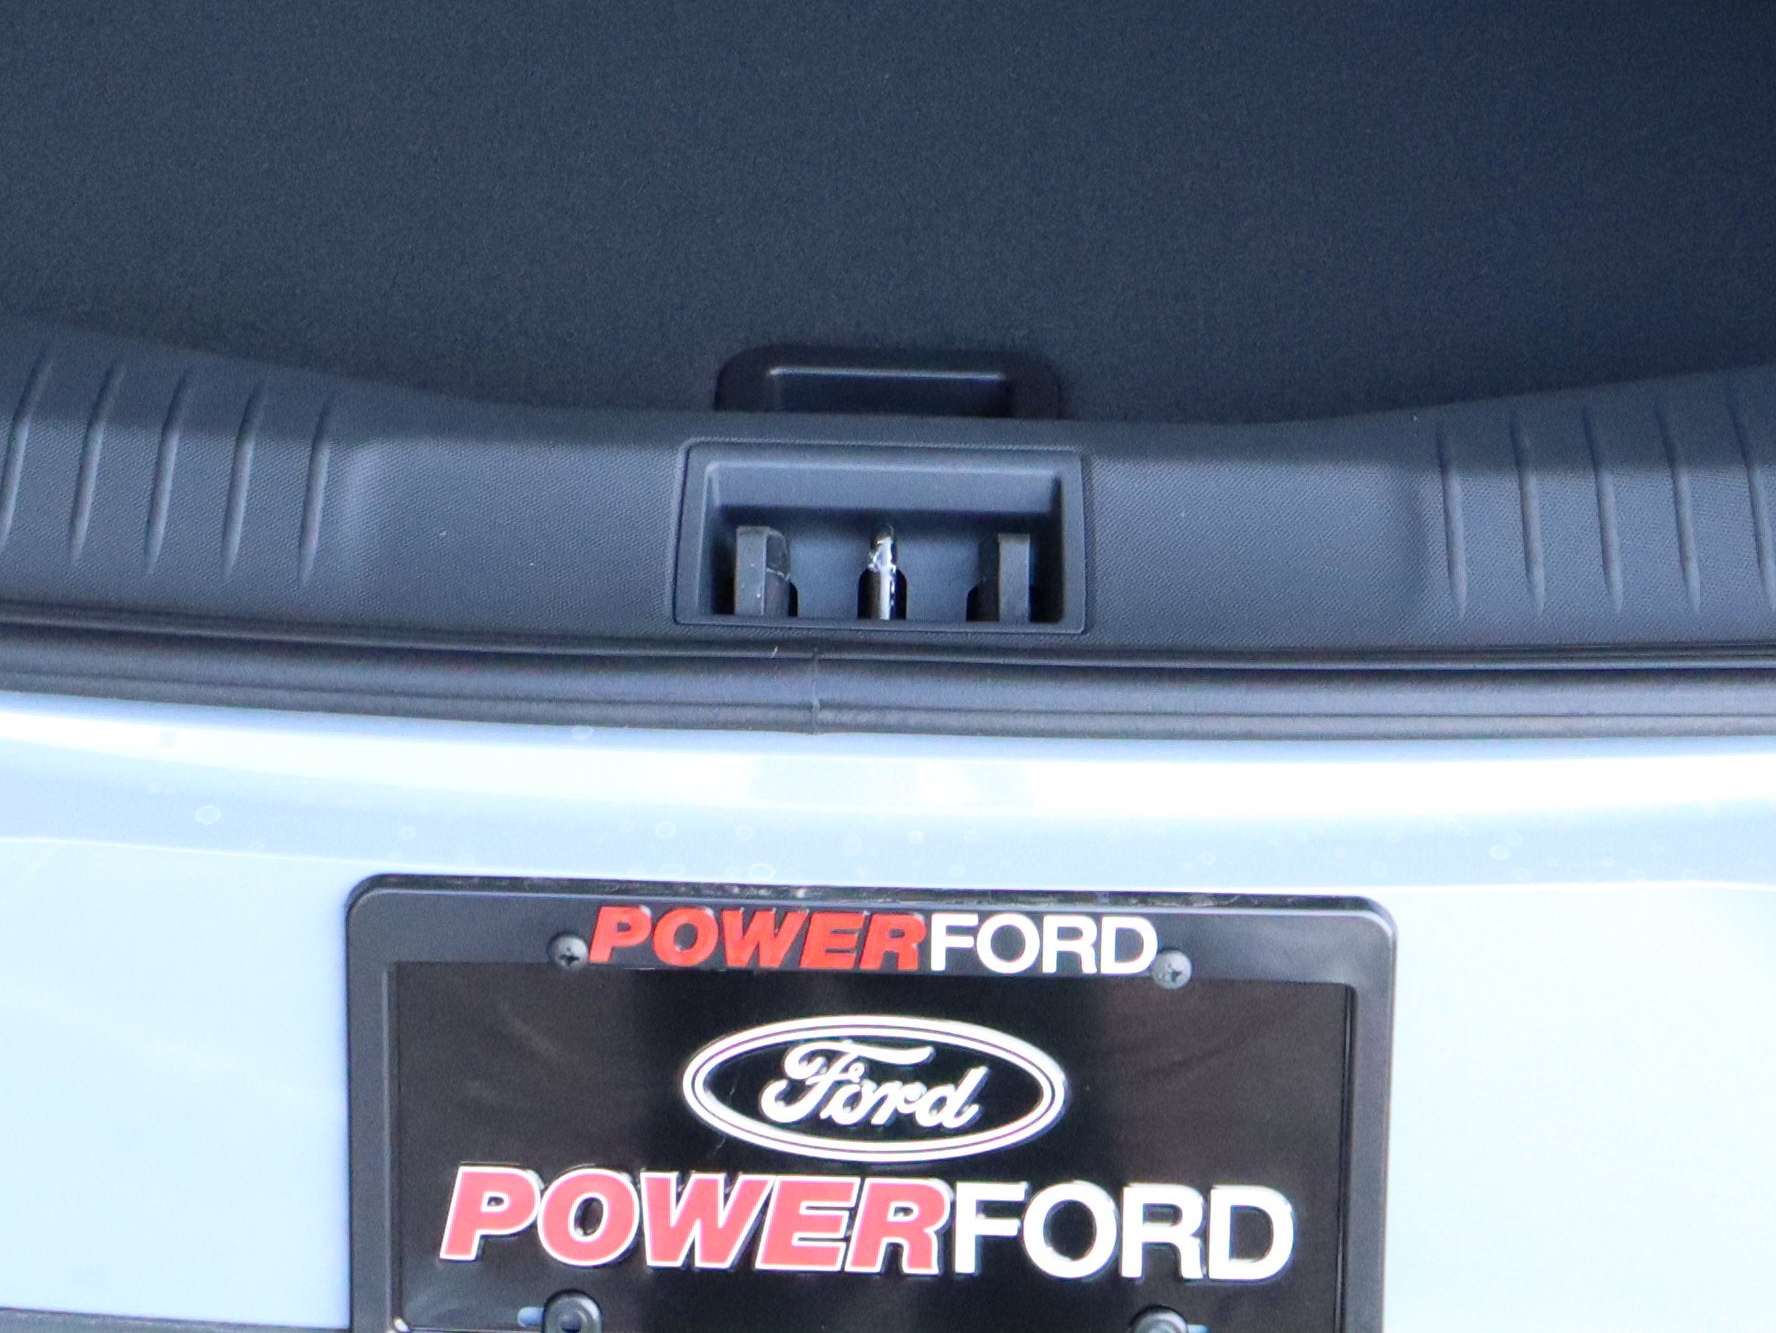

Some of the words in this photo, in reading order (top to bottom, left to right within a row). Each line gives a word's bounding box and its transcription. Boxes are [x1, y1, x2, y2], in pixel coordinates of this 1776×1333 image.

[588, 906, 1159, 976] POWERFORD
[759, 1040, 990, 1130] Ford
[437, 1165, 1297, 1283] POWERFORD
